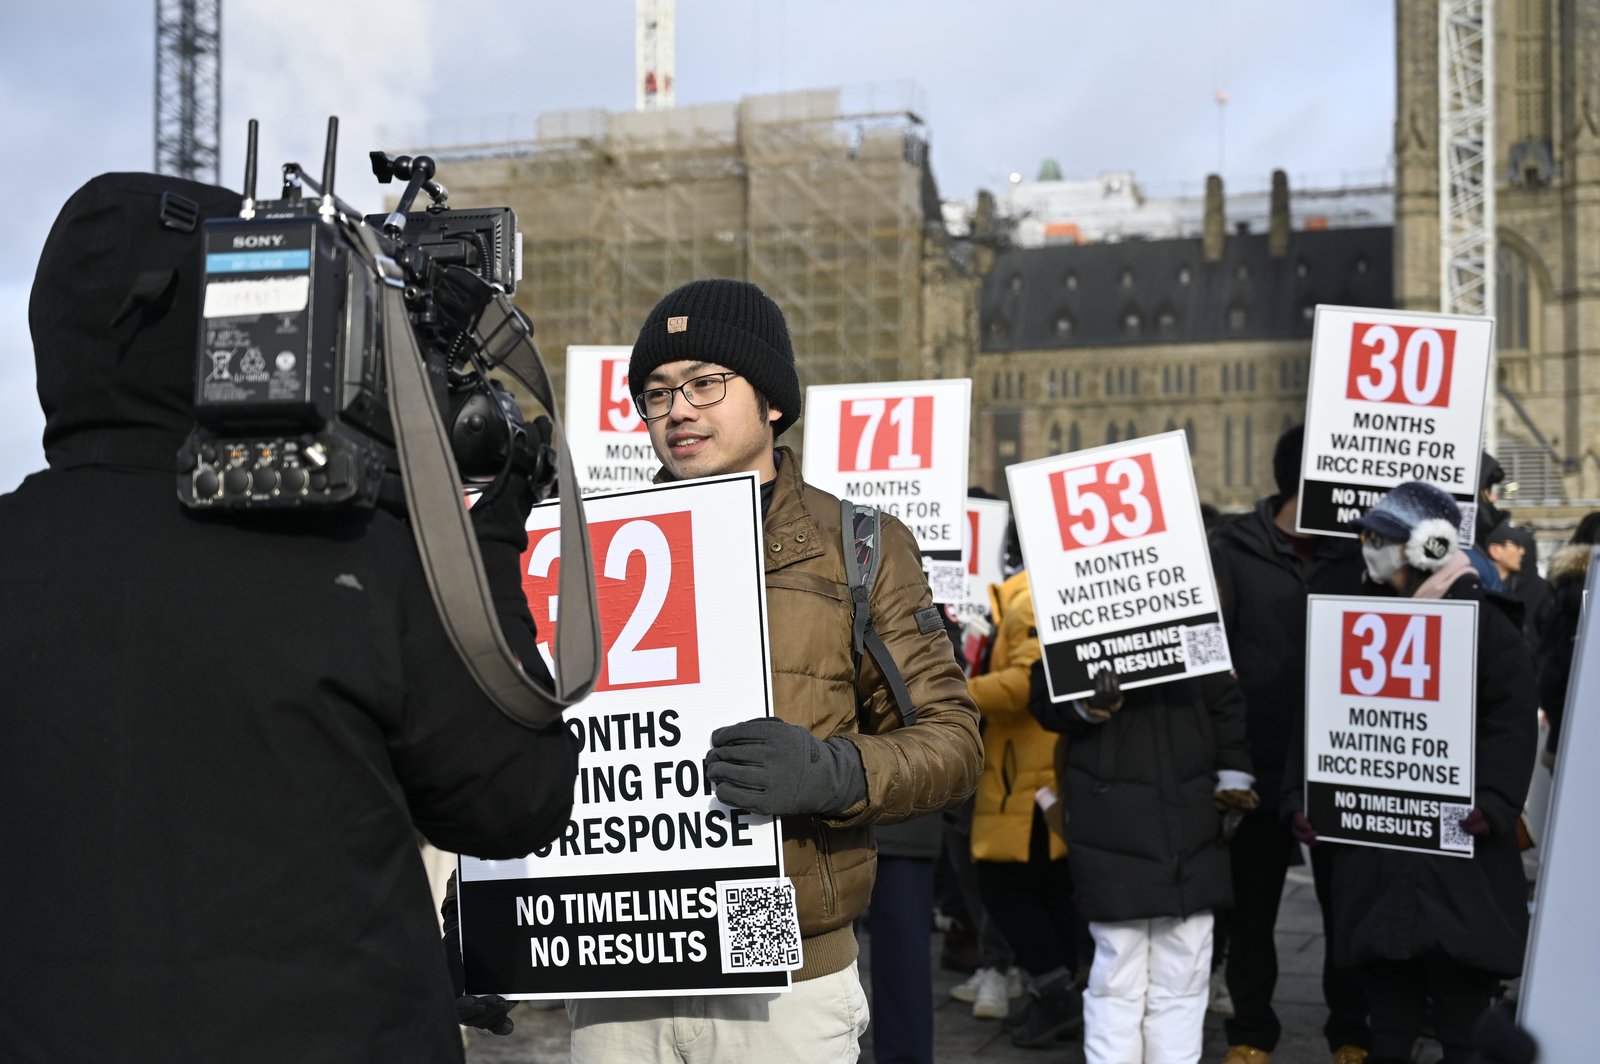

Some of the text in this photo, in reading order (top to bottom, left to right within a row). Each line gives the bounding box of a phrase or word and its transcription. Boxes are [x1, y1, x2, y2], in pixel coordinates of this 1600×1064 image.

[232, 234, 284, 248] SONY
[1356, 324, 1444, 405] 30
[607, 360, 642, 432] 5
[851, 397, 921, 471] 71
[1353, 412, 1435, 435] MONTHS
[606, 444, 659, 460] MONT
[1331, 433, 1455, 460] WAITING FOR
[1317, 455, 1465, 484] IRCC RESPONSE
[846, 480, 921, 497] MONTHS
[1063, 457, 1153, 547] 53
[1331, 488, 1356, 505] NO
[906, 502, 941, 518] FOR
[1075, 547, 1158, 578] MONTHS
[1058, 566, 1186, 606] WAITING FOR
[1050, 587, 1203, 632] IRCC RESPONSE
[1075, 641, 1100, 661] NO
[1114, 645, 1186, 675] RESULTS
[1349, 613, 1431, 698] 34
[564, 709, 681, 753] ONTHS
[1349, 707, 1427, 731] MONTHS
[1329, 730, 1448, 759] WAITING FOR
[1318, 754, 1460, 785] IRCC RESPONSE
[1335, 790, 1439, 817] NO TIMELINES
[560, 809, 753, 857] RESPONSE
[1341, 813, 1433, 838] NO RESULTS
[516, 887, 718, 926] NO TIMELINES
[530, 930, 707, 967] NO RESULTS
